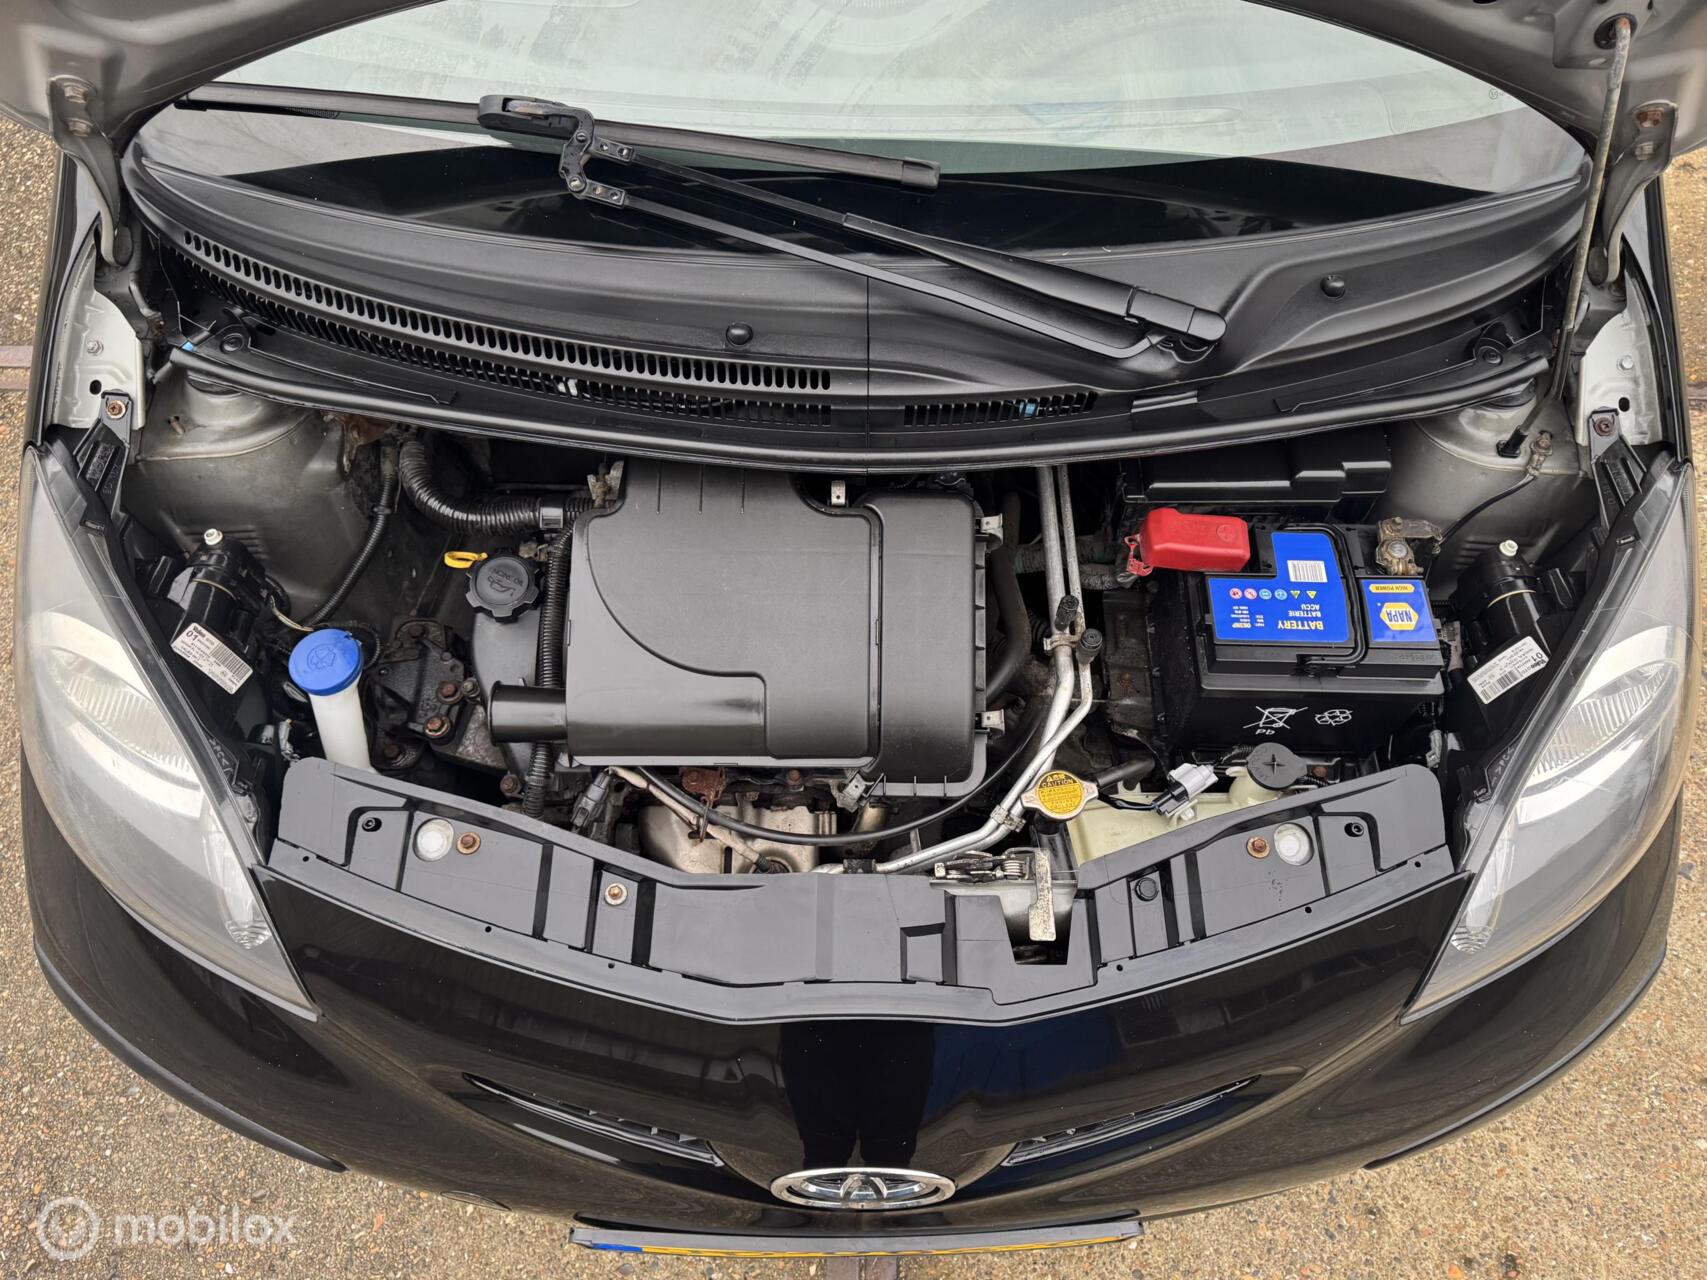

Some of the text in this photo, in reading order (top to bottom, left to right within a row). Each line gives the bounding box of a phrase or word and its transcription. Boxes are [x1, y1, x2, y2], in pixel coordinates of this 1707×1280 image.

[1385, 609, 1413, 623] NAPA
[1277, 620, 1324, 630] BATTERY
[185, 630, 199, 641] 01
[1531, 651, 1543, 662] 01
[1041, 778, 1074, 788] CAUTION
